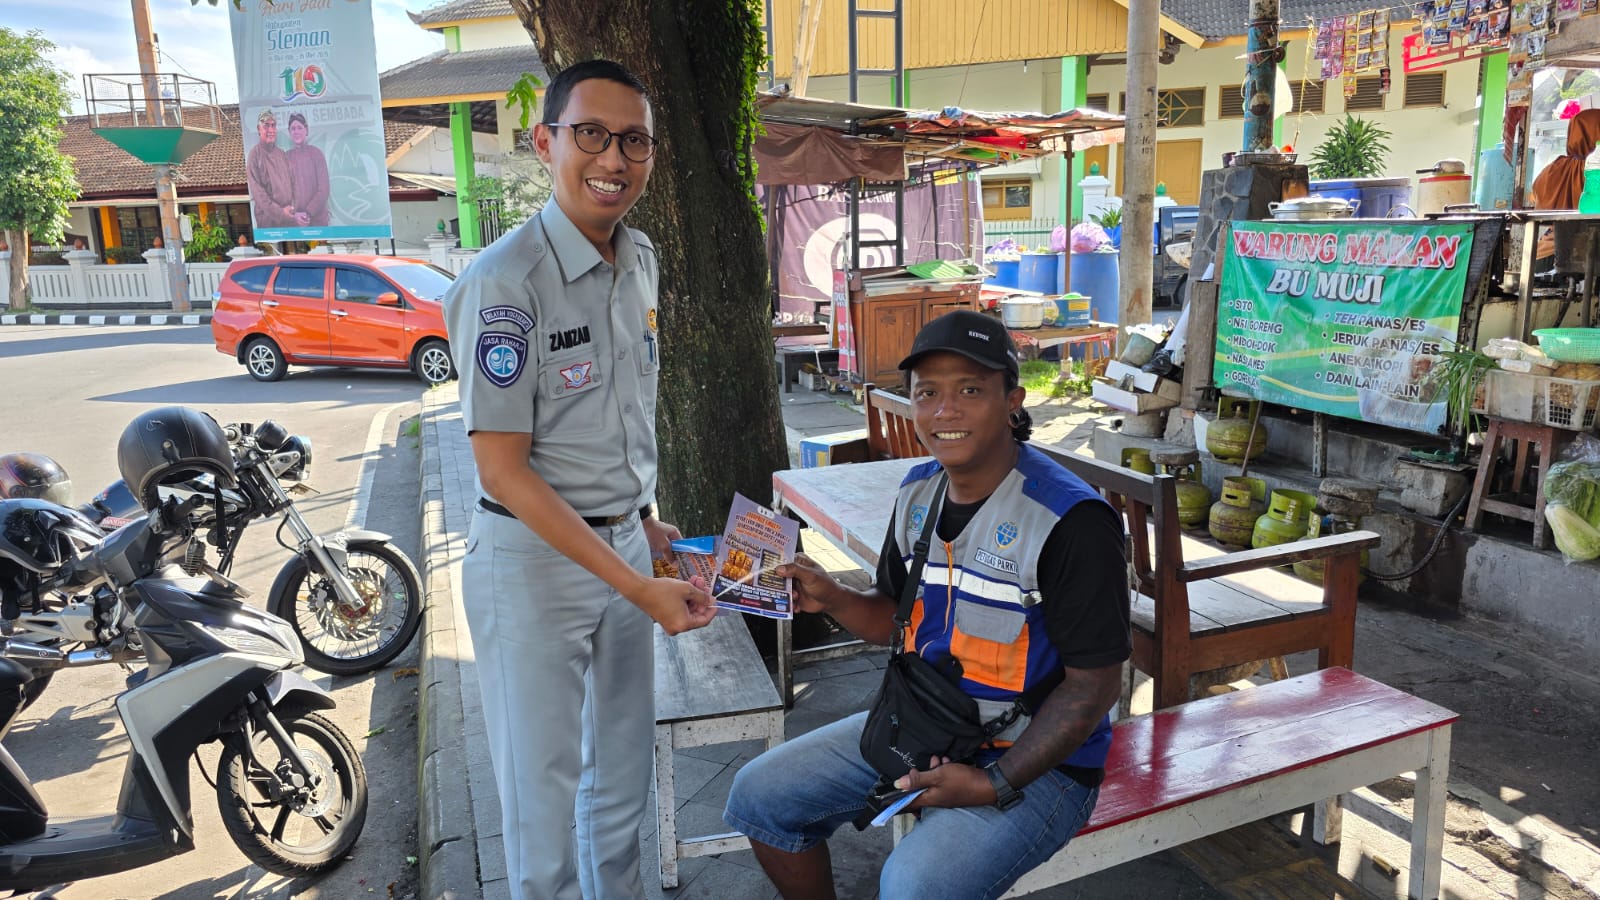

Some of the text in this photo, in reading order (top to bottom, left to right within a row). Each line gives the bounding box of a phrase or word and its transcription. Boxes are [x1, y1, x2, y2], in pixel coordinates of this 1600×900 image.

[267, 29, 331, 51] Sleman
[1233, 230, 1461, 269] WARUNG MAKAN
[1265, 268, 1385, 305] BU MUJI
[1334, 313, 1357, 325] TEH
[483, 337, 500, 345] JASA
[1332, 332, 1368, 347] JERUK
[1326, 372, 1353, 386] DAN
